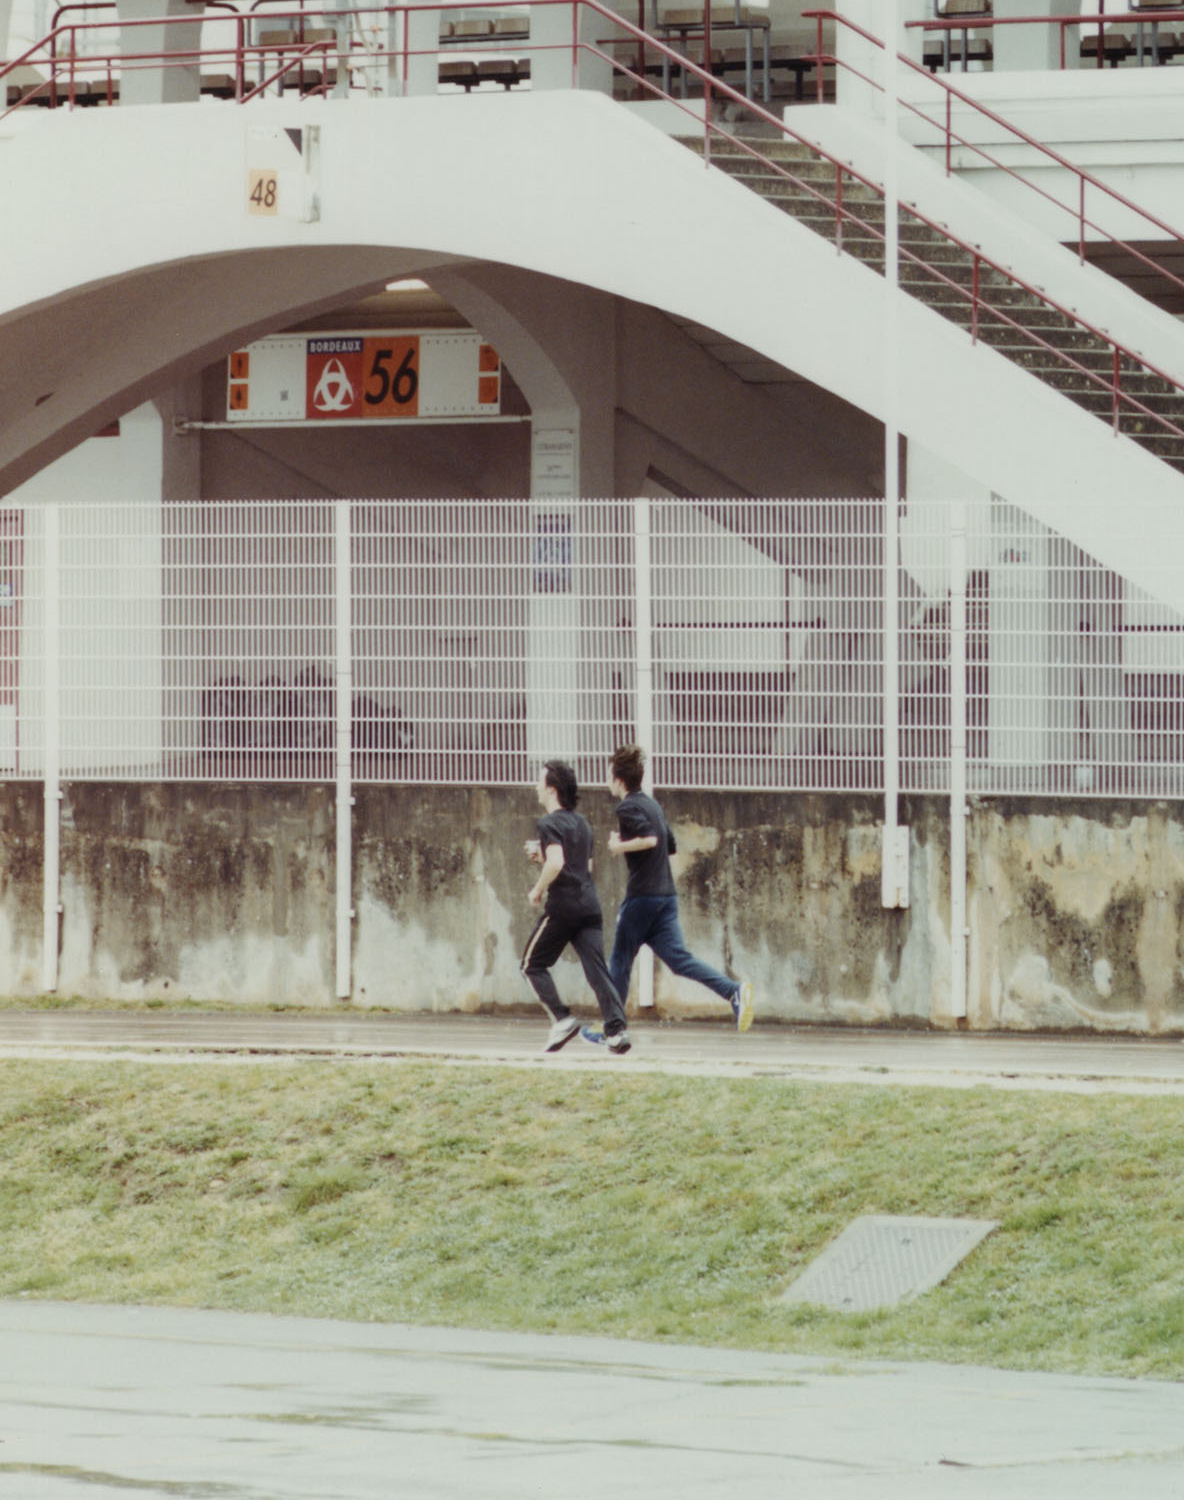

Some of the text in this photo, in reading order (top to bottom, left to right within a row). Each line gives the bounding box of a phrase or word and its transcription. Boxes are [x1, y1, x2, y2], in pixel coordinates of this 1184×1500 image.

[250, 178, 277, 208] 48
[309, 340, 361, 352] BORDEAUX
[364, 348, 419, 405] 56
